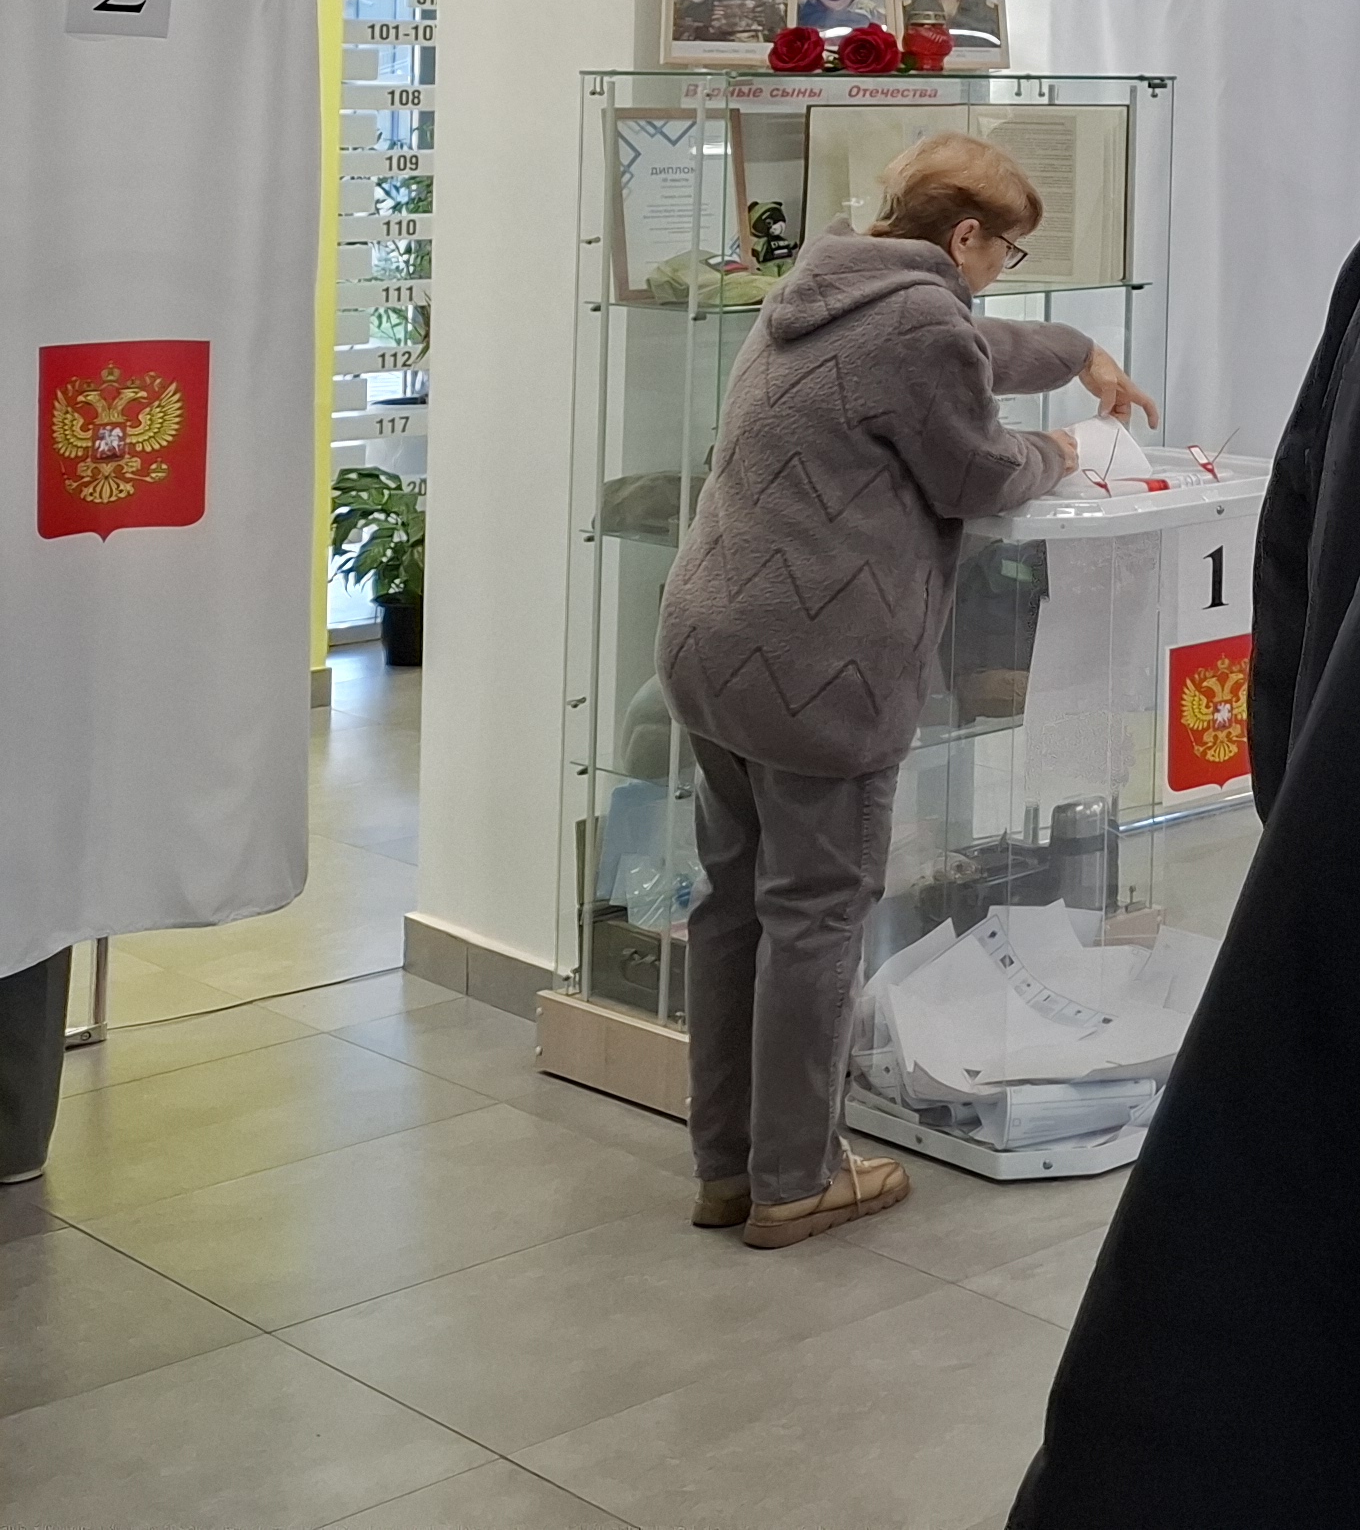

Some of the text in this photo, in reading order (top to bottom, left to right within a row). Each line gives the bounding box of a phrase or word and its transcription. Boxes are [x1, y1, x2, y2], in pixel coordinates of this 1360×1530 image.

[367, 23, 437, 41] 101-10
[387, 89, 422, 106] 108
[684, 83, 939, 101] Врные сыны Отечества
[385, 154, 419, 172] 109
[382, 219, 417, 237] 110
[382, 285, 414, 303] 111
[378, 351, 413, 369] 112
[375, 416, 410, 435] 117
[1202, 545, 1230, 610] 1
